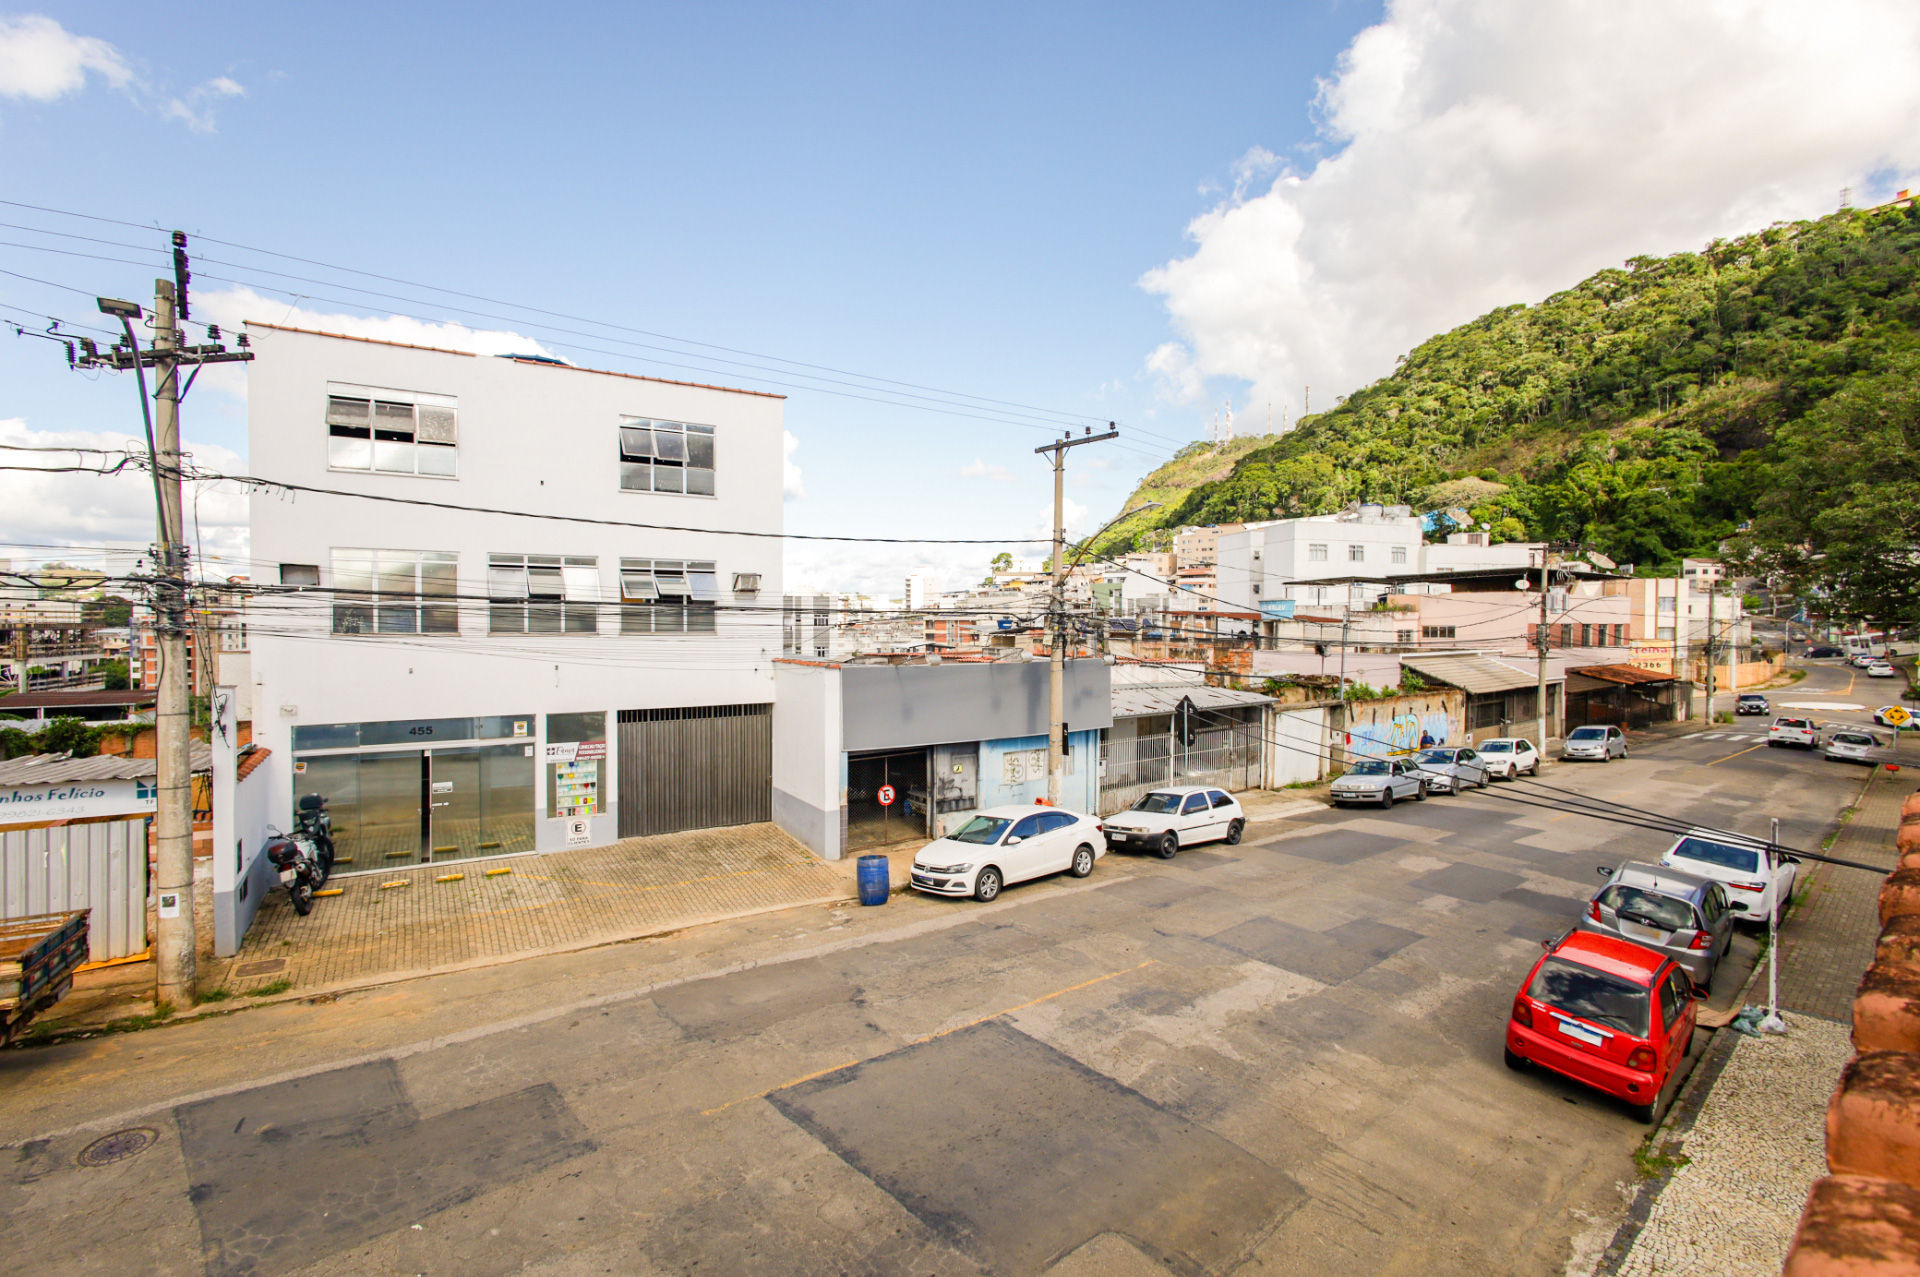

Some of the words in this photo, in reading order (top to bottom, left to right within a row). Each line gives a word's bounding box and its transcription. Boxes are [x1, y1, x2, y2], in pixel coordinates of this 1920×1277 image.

[409, 726, 433, 736] 455
[1827, 724, 1871, 732] PARE
[47, 787, 105, 801] Felício
[574, 824, 582, 832] E
